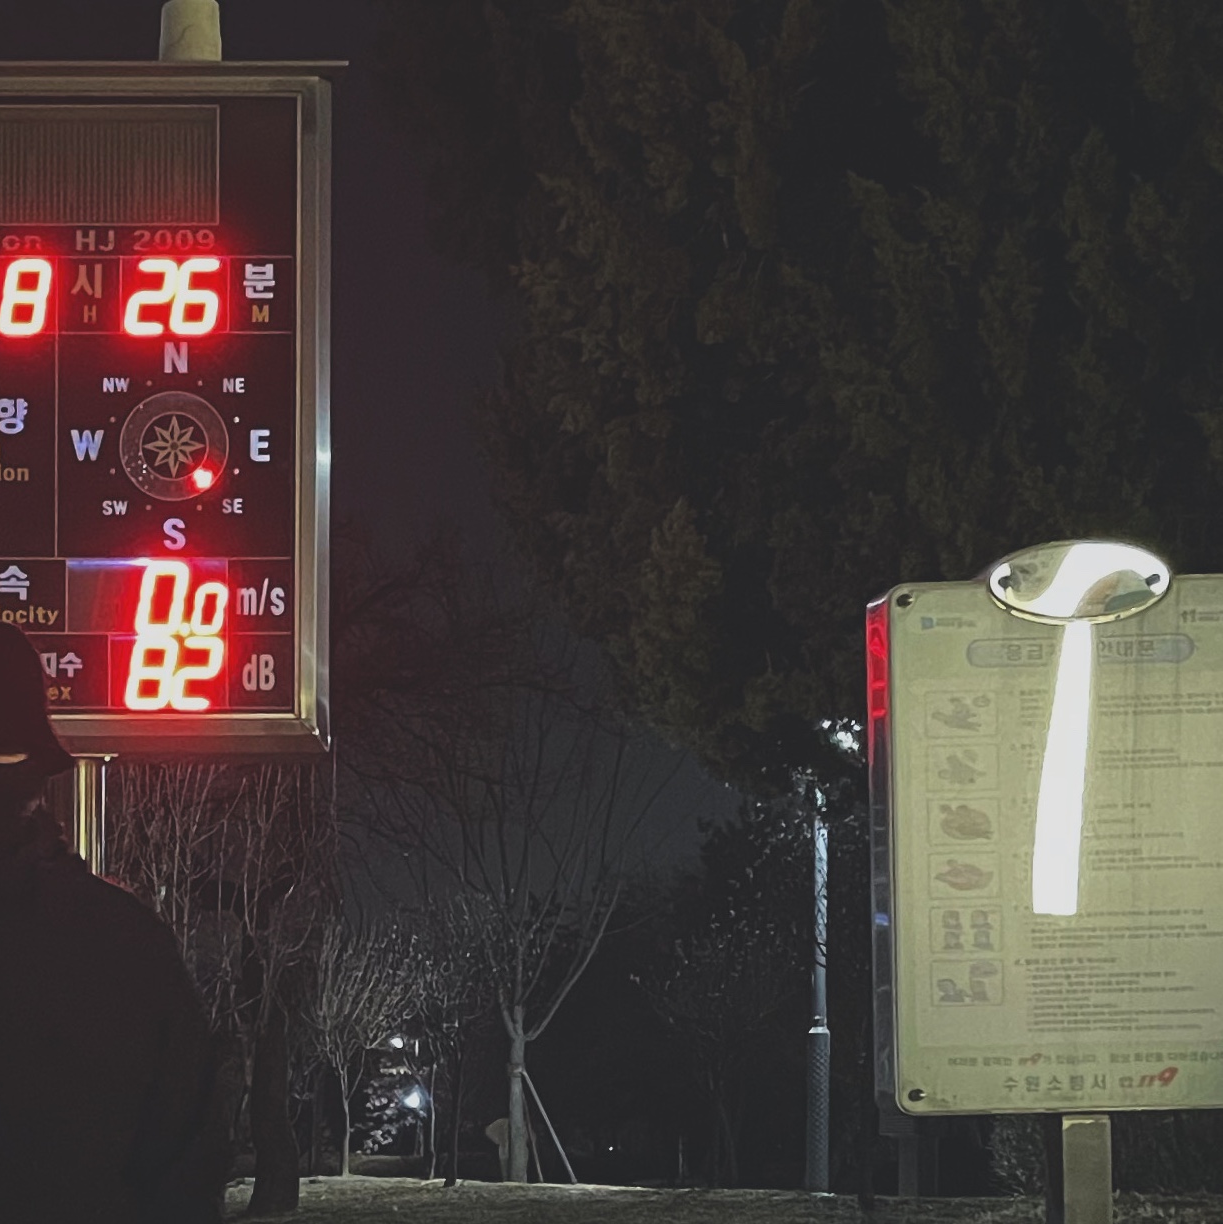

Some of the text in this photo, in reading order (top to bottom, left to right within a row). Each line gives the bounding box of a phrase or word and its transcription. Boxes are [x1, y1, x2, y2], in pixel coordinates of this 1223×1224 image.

[76, 229, 115, 252] HJ
[133, 229, 216, 250] 2009
[70, 262, 103, 299] 시
[123, 257, 221, 337] 26
[242, 262, 277, 299] 분
[83, 305, 97, 324] H
[251, 305, 270, 323] M
[163, 341, 189, 374] N
[102, 377, 130, 393] NW
[222, 377, 246, 393] NE
[70, 429, 105, 461] W
[249, 429, 271, 462] E
[102, 500, 129, 515] SW
[221, 498, 244, 514] SE
[163, 517, 187, 551] S
[135, 561, 229, 636] 0.0
[236, 577, 286, 617] m/s
[124, 634, 224, 711] 82
[242, 653, 276, 692] dB
